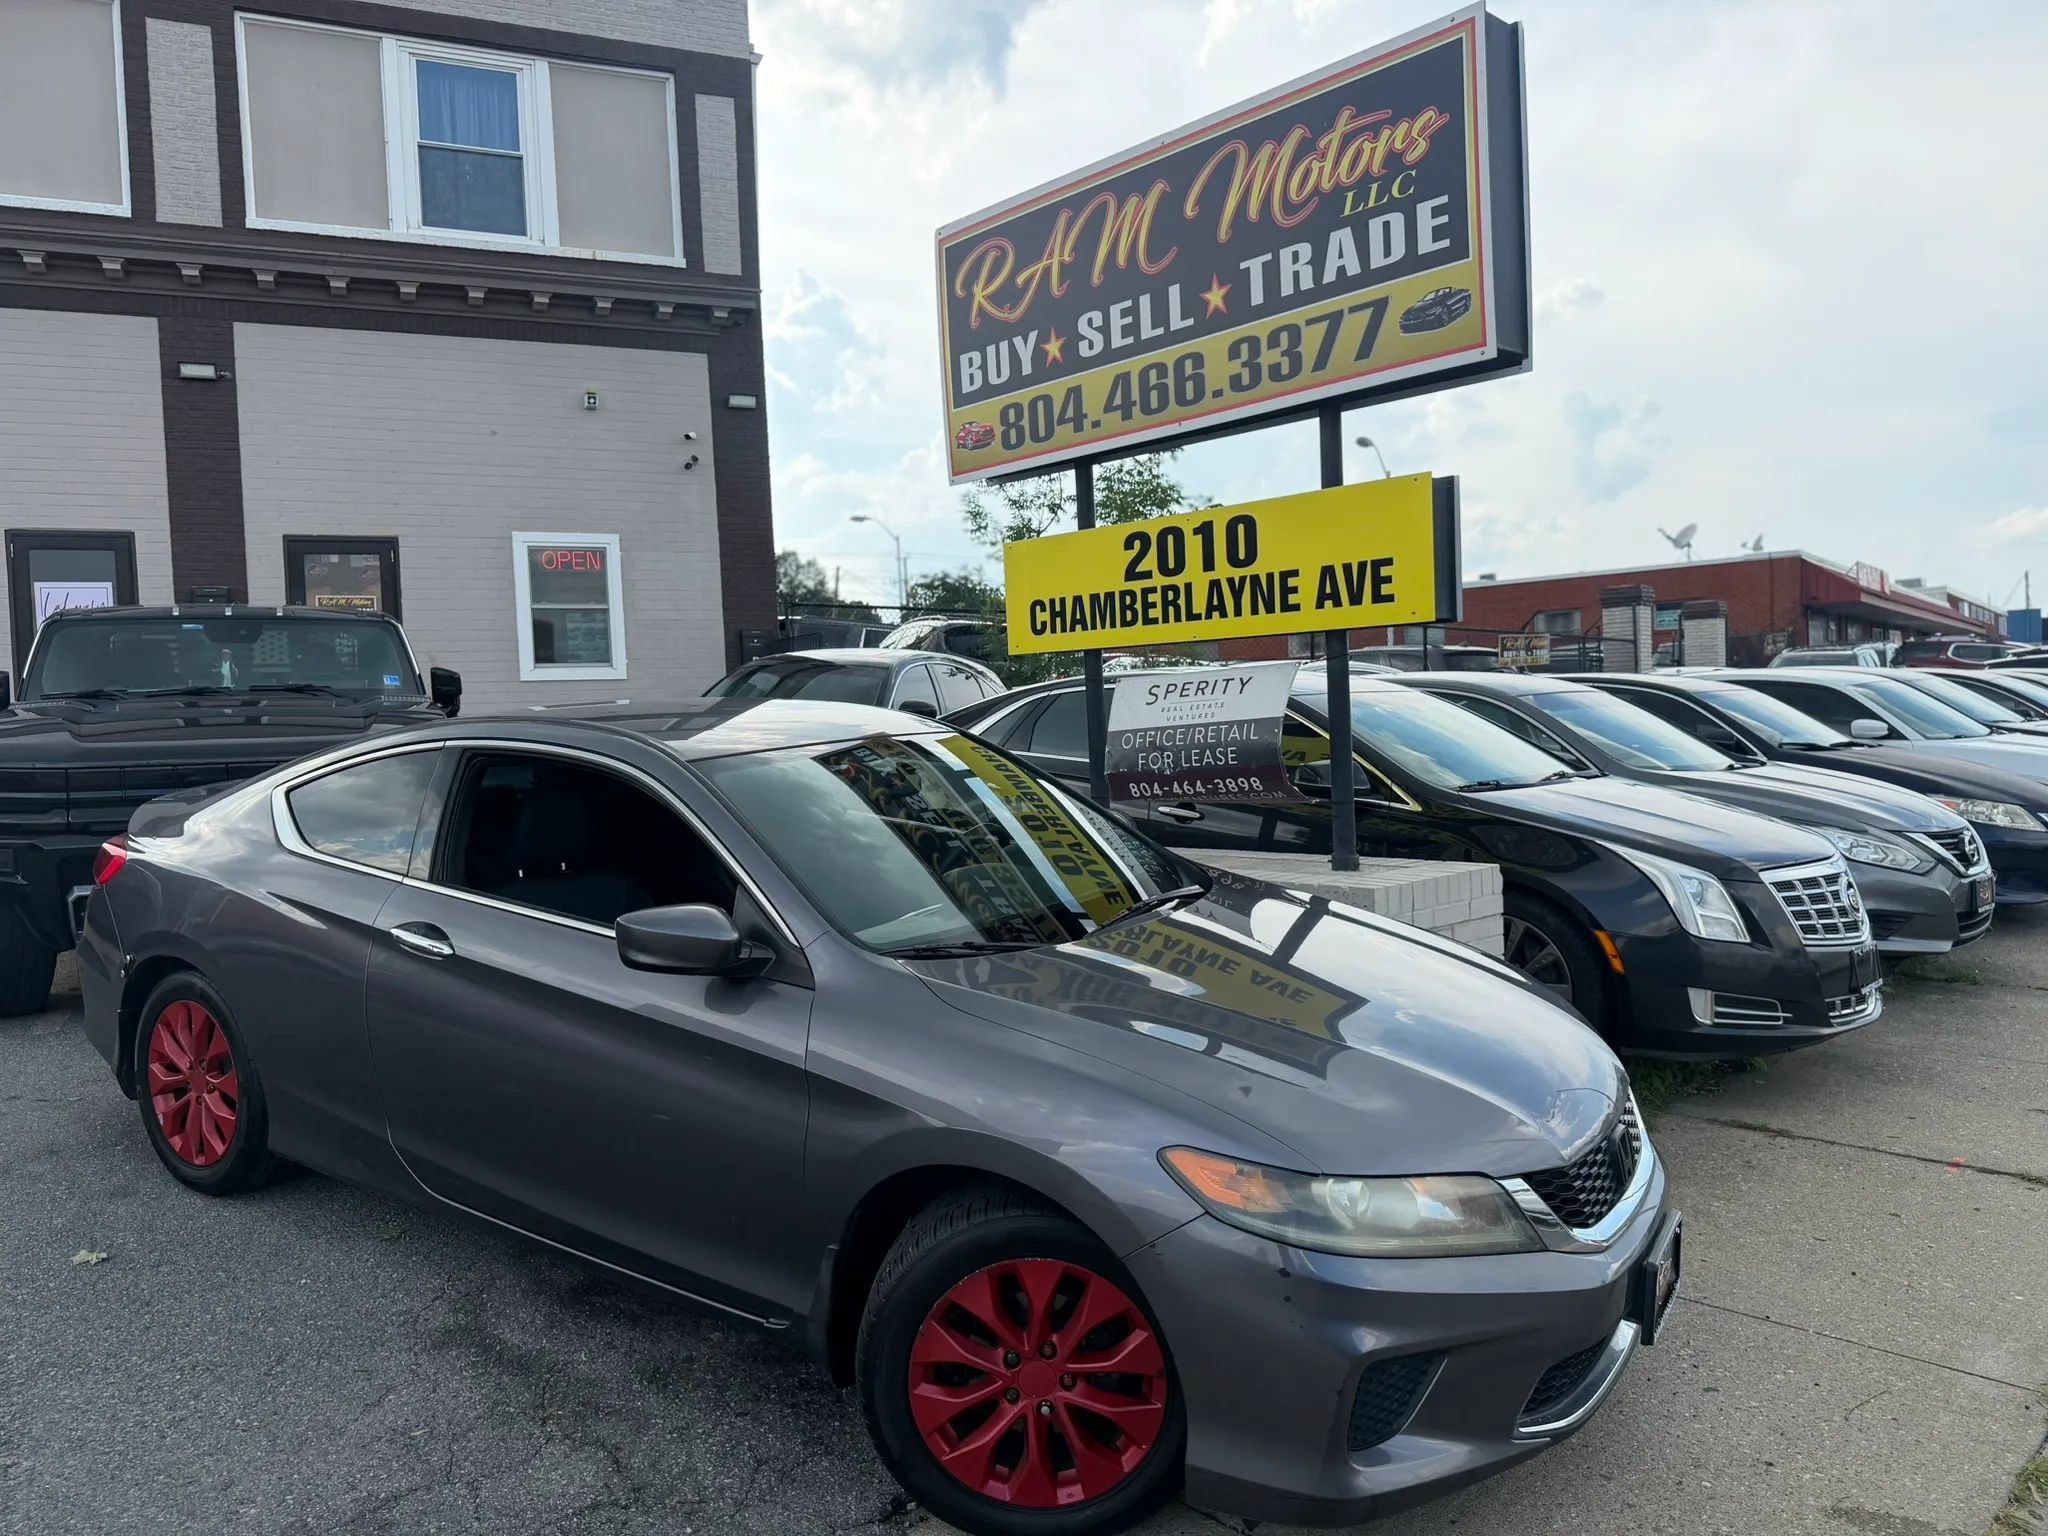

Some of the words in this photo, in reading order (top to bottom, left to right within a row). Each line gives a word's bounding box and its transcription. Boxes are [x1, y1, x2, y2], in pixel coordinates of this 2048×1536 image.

[1342, 169, 1417, 217] LLC
[955, 179, 1178, 329] RAM
[1185, 105, 1451, 244] Motors
[959, 332, 1039, 395] BUY
[1077, 282, 1195, 359] SELL
[1239, 195, 1451, 307] TRADE
[999, 295, 1391, 452] 804.466.3377
[541, 549, 603, 571] OPEN
[1122, 513, 1258, 584] 2010
[1029, 568, 1301, 637] CHAMBERLAYNE
[1315, 556, 1396, 611] AVE
[1145, 676, 1253, 706] SPERITY
[1189, 701, 1225, 711] ESTATE
[1166, 712, 1216, 722] VENTURES
[1121, 722, 1259, 749] OFFICE/RETAIL
[1138, 752, 1174, 772] FOR
[1181, 747, 1238, 767] LEASE
[1129, 776, 1264, 798] 804-464-3898
